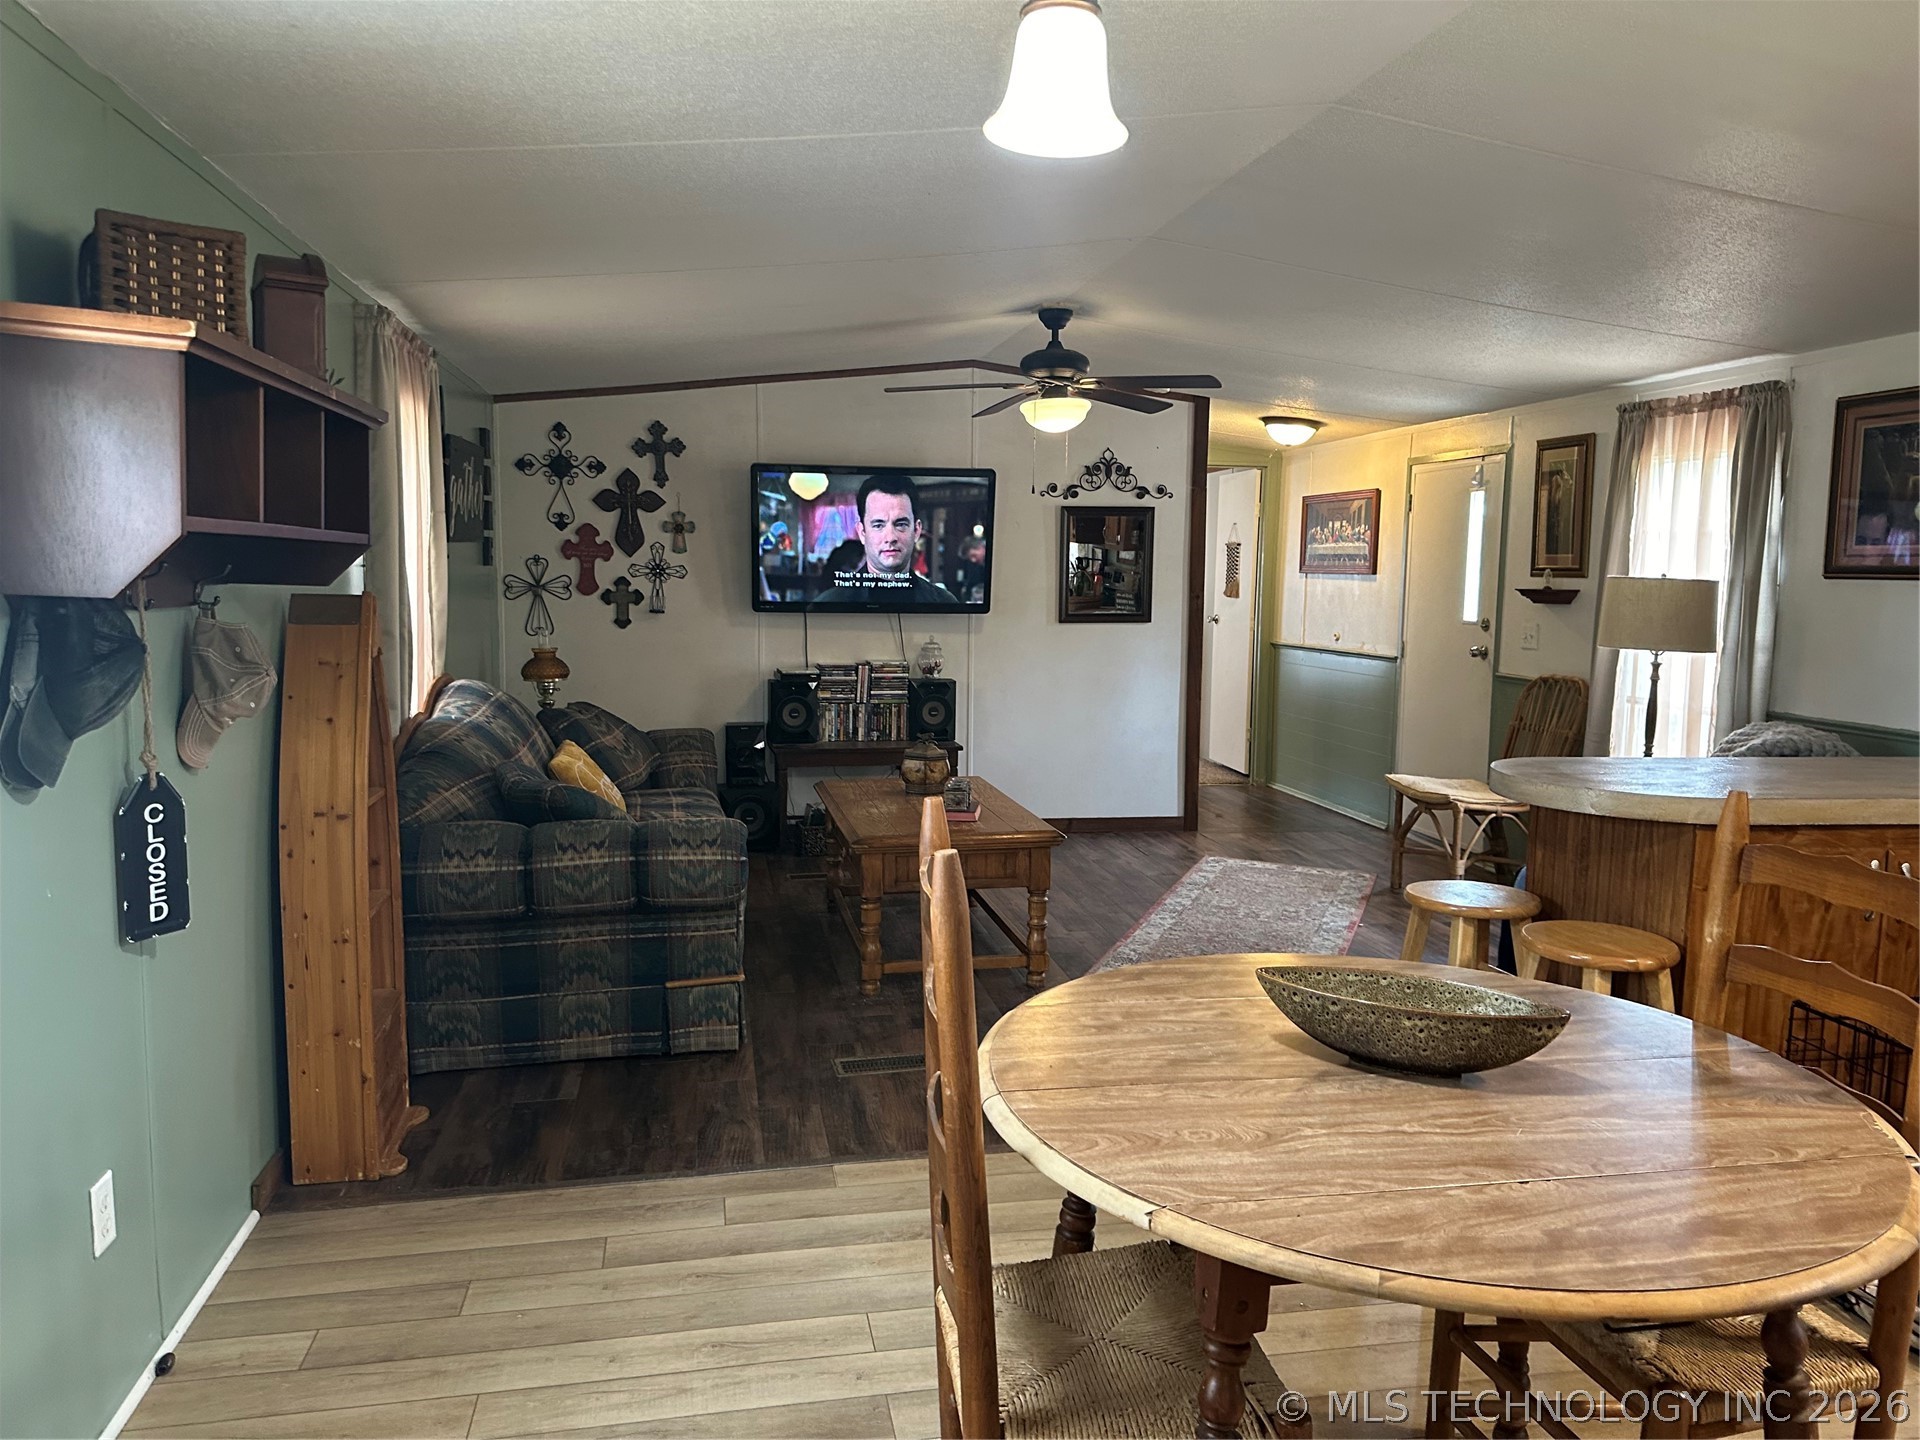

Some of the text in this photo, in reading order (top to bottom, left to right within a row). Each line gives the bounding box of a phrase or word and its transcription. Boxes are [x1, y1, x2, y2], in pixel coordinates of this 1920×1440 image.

[834, 571, 861, 579] That's
[894, 571, 913, 579] dad.
[833, 579, 861, 587] That's
[877, 580, 913, 589] nephew.
[143, 803, 169, 923] CLOSED
